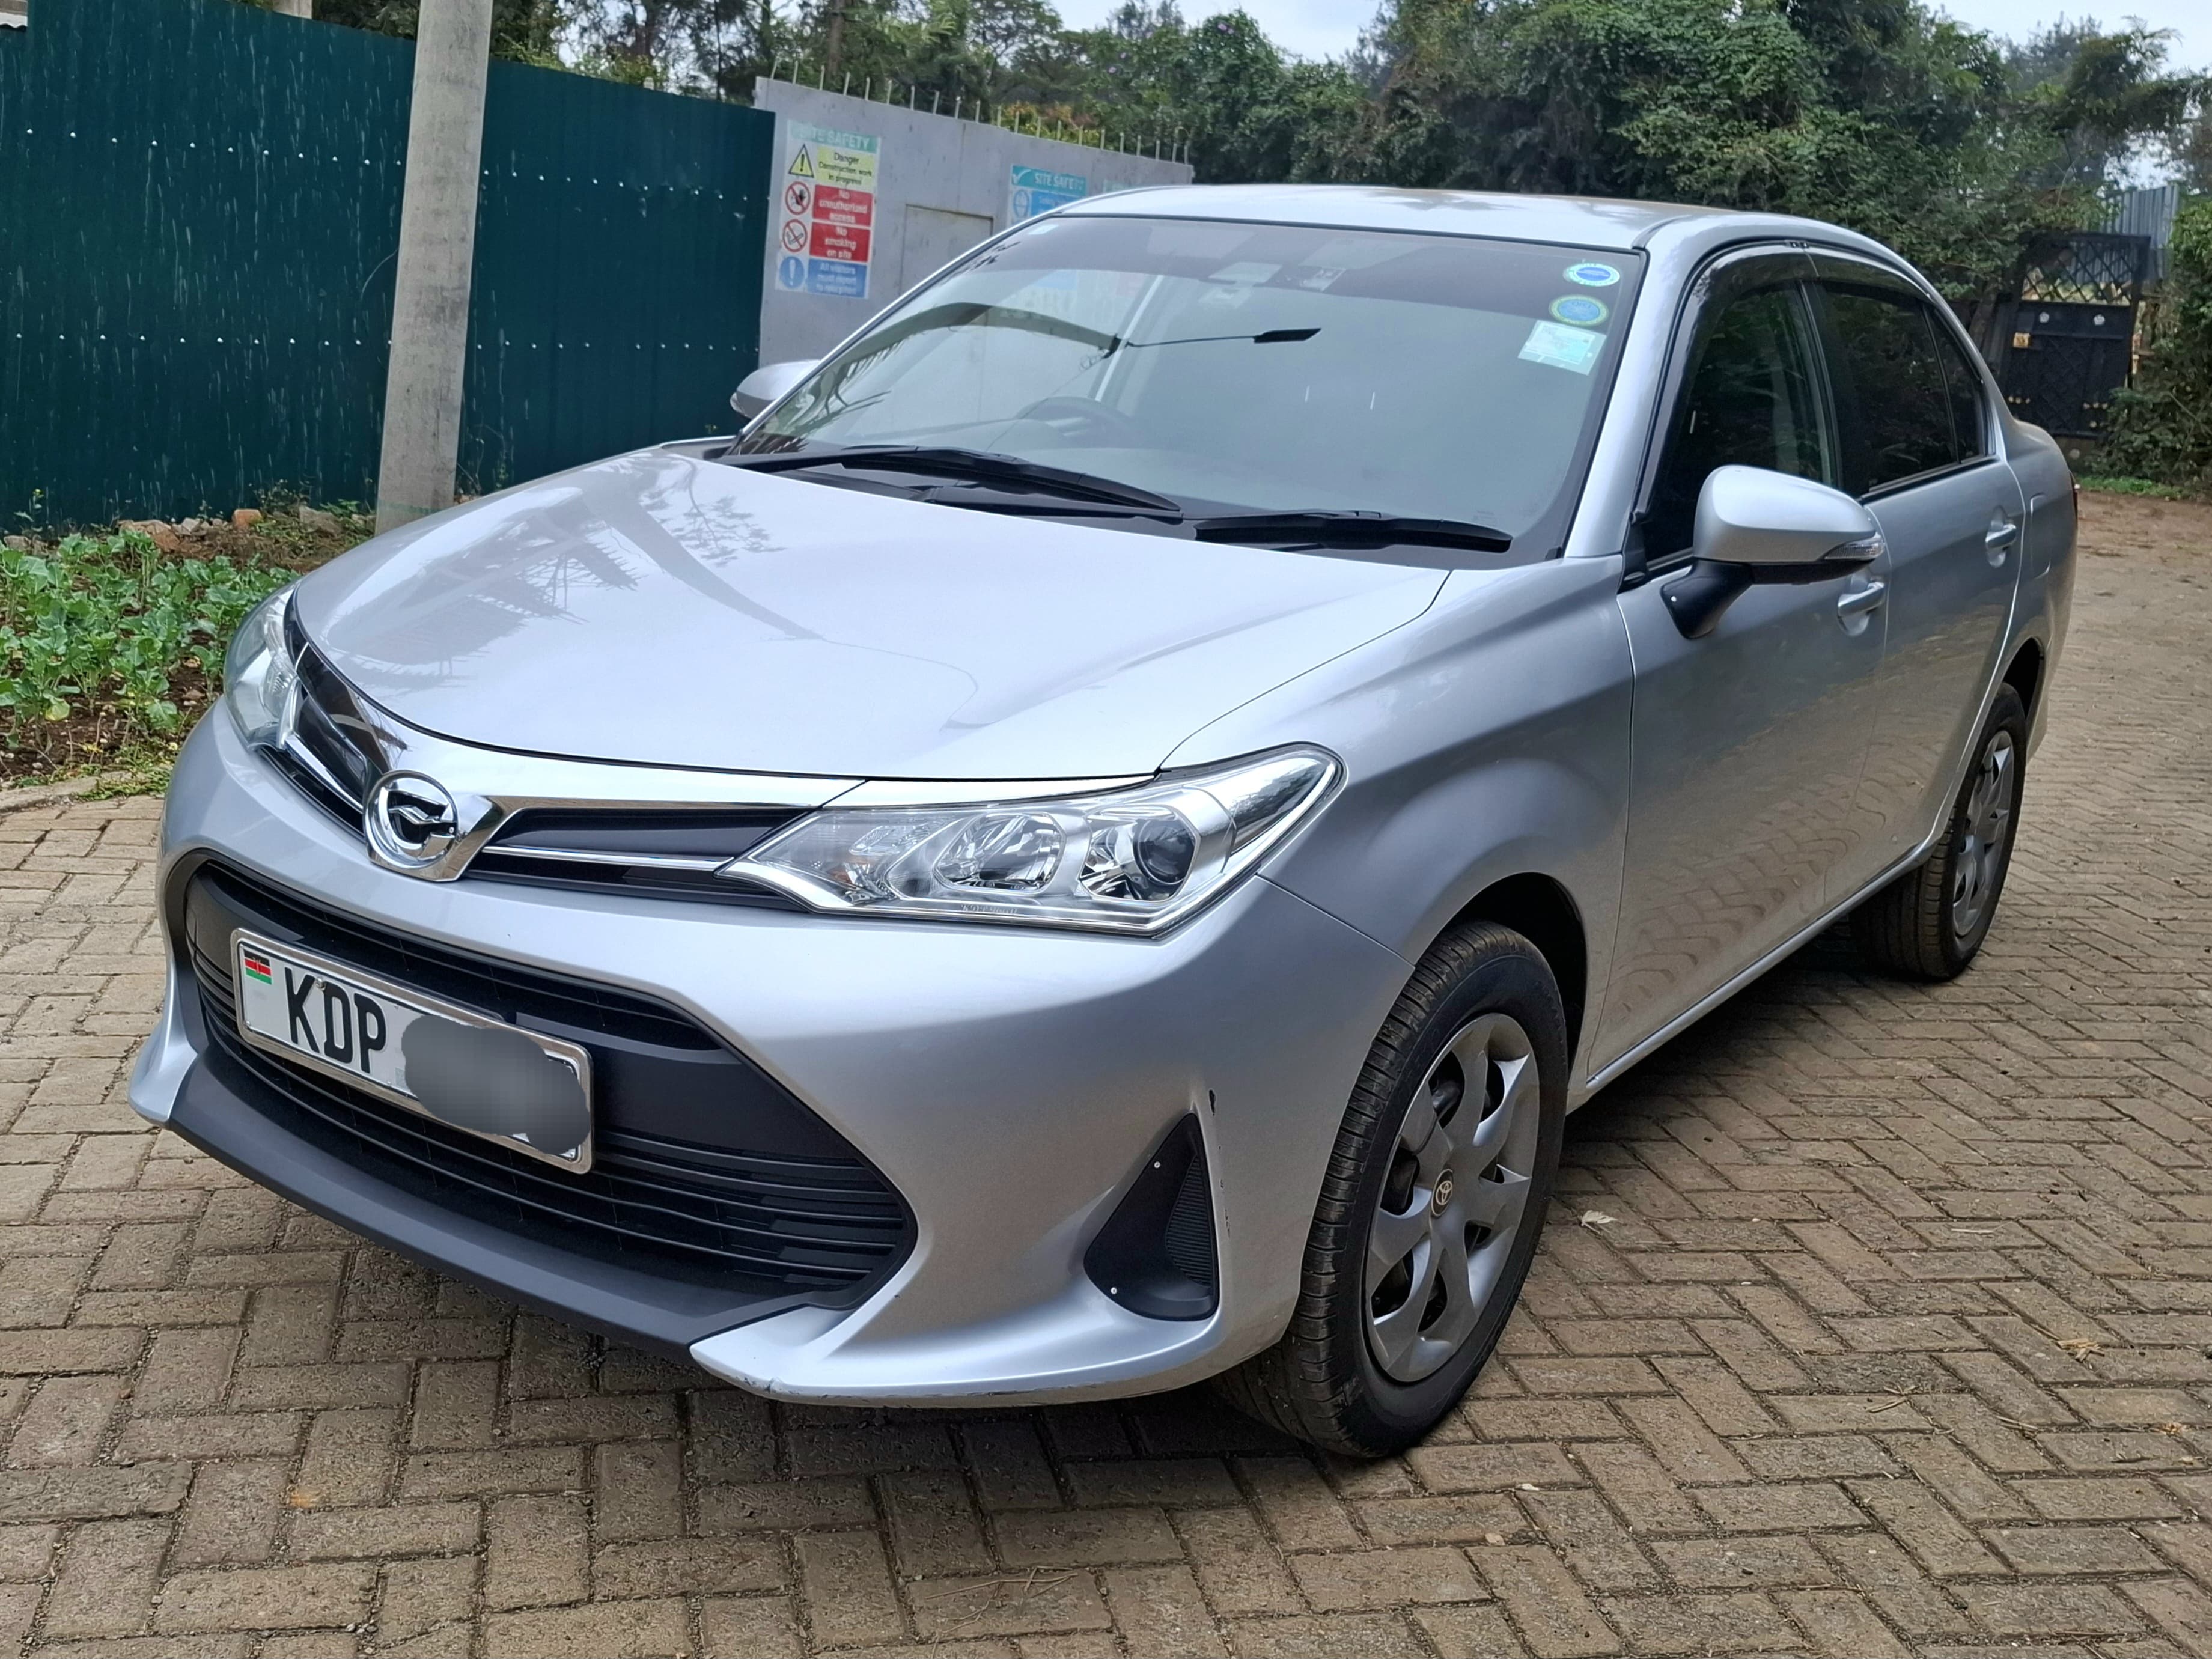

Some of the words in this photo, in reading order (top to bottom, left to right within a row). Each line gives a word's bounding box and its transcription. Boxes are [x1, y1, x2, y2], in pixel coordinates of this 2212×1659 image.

[827, 130, 870, 150] SAFETY
[833, 151, 859, 166] Danger
[1035, 172, 1052, 186] SITE
[839, 189, 850, 199] No
[836, 226, 847, 236] No
[824, 237, 856, 251] smoking
[284, 967, 386, 1074] KDP
